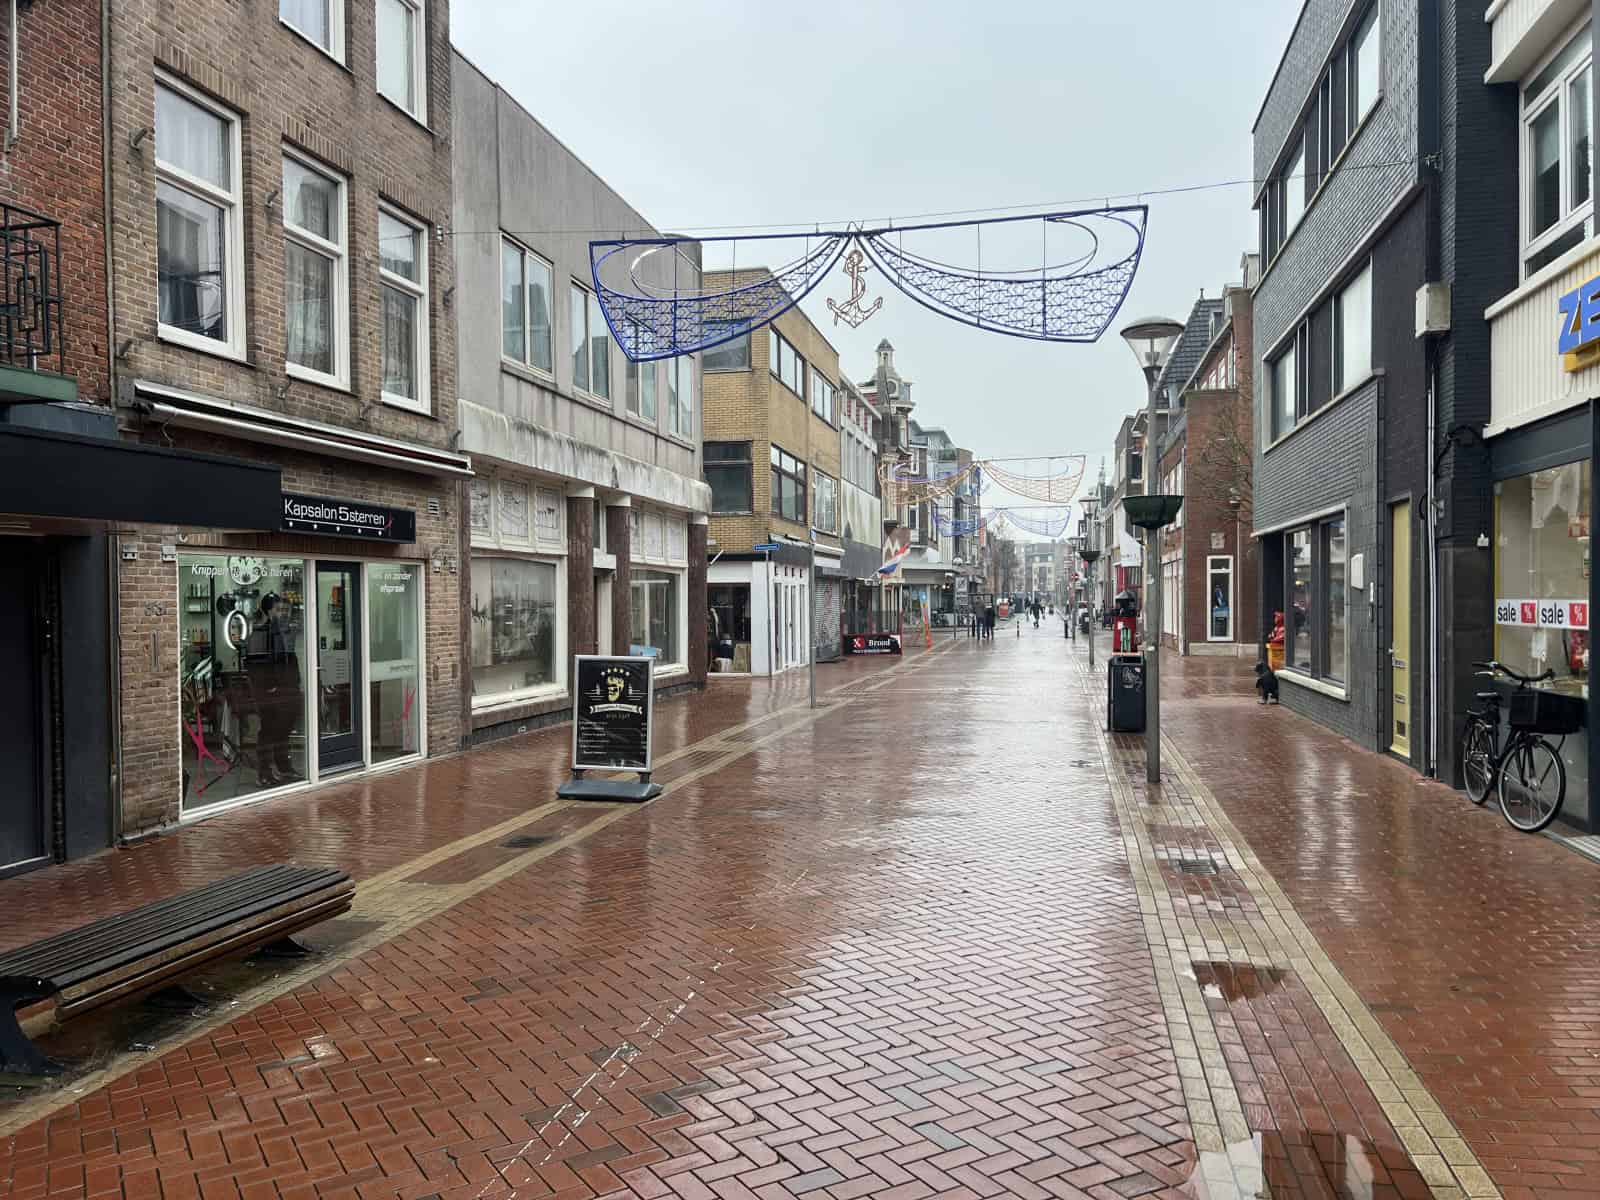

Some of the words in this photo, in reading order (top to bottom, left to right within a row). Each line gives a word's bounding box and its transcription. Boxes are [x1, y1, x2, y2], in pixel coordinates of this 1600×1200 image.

[284, 498, 337, 520] Kapsalon
[1497, 602, 1517, 622] sale
[1541, 602, 1564, 625] sale
